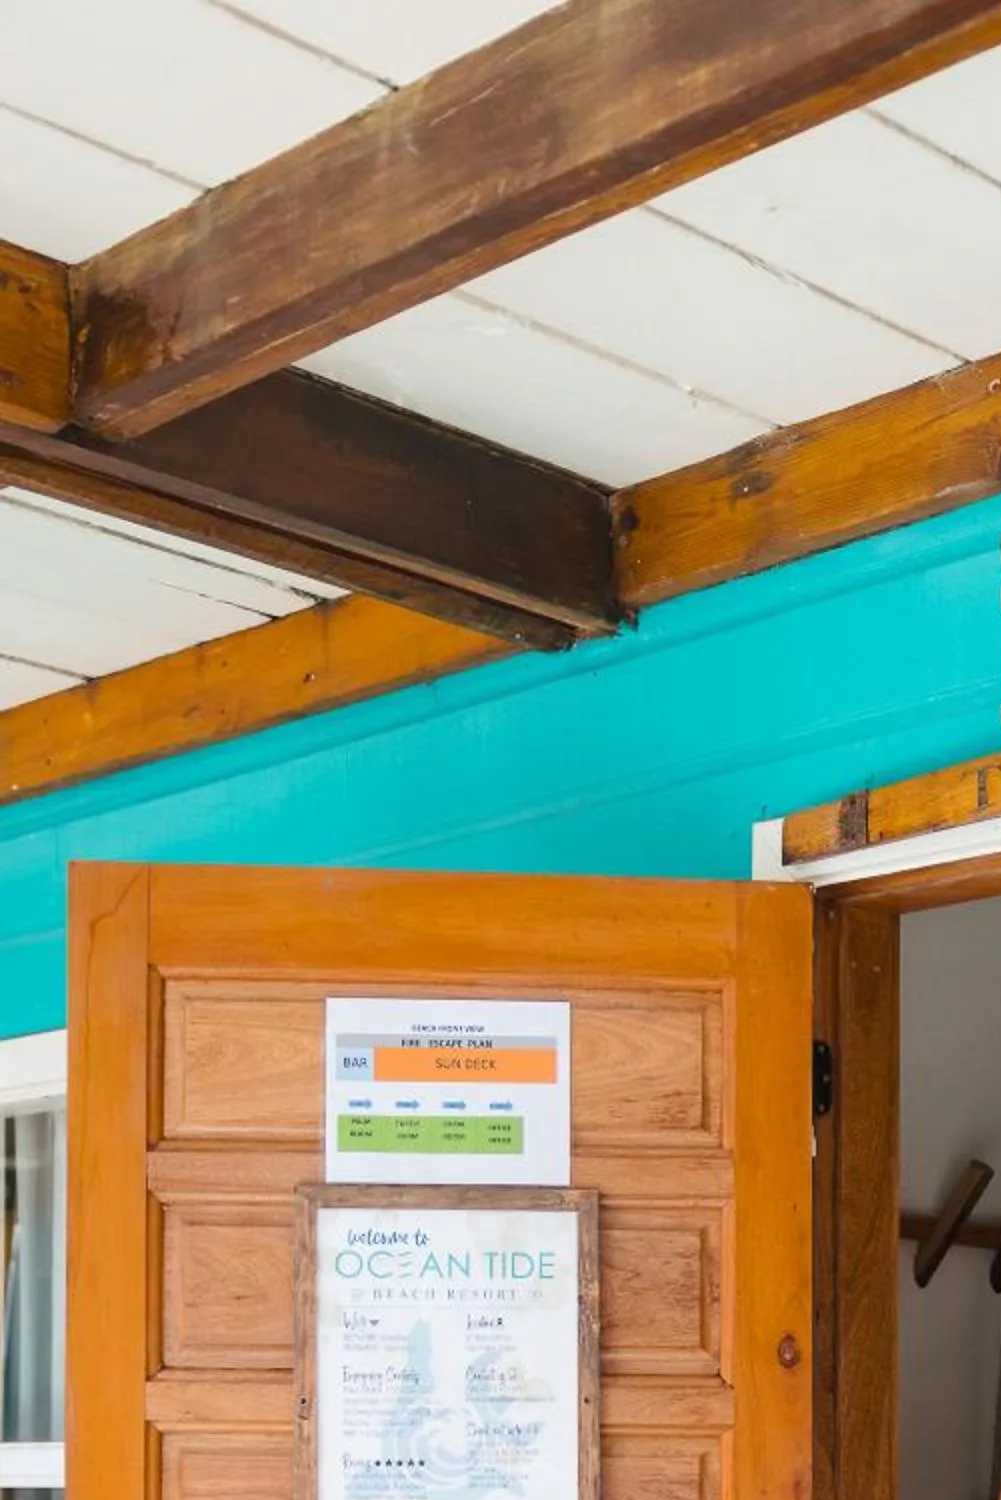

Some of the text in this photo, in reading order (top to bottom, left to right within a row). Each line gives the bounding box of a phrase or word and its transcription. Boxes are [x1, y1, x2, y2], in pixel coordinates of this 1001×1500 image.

[467, 1039, 493, 1048] PLAN
[343, 1056, 368, 1069] BAR
[435, 1057, 497, 1071] SUN DECK
[335, 1251, 555, 1279] OCEAN TIDE
[373, 1289, 518, 1300] BEACH RESORT
